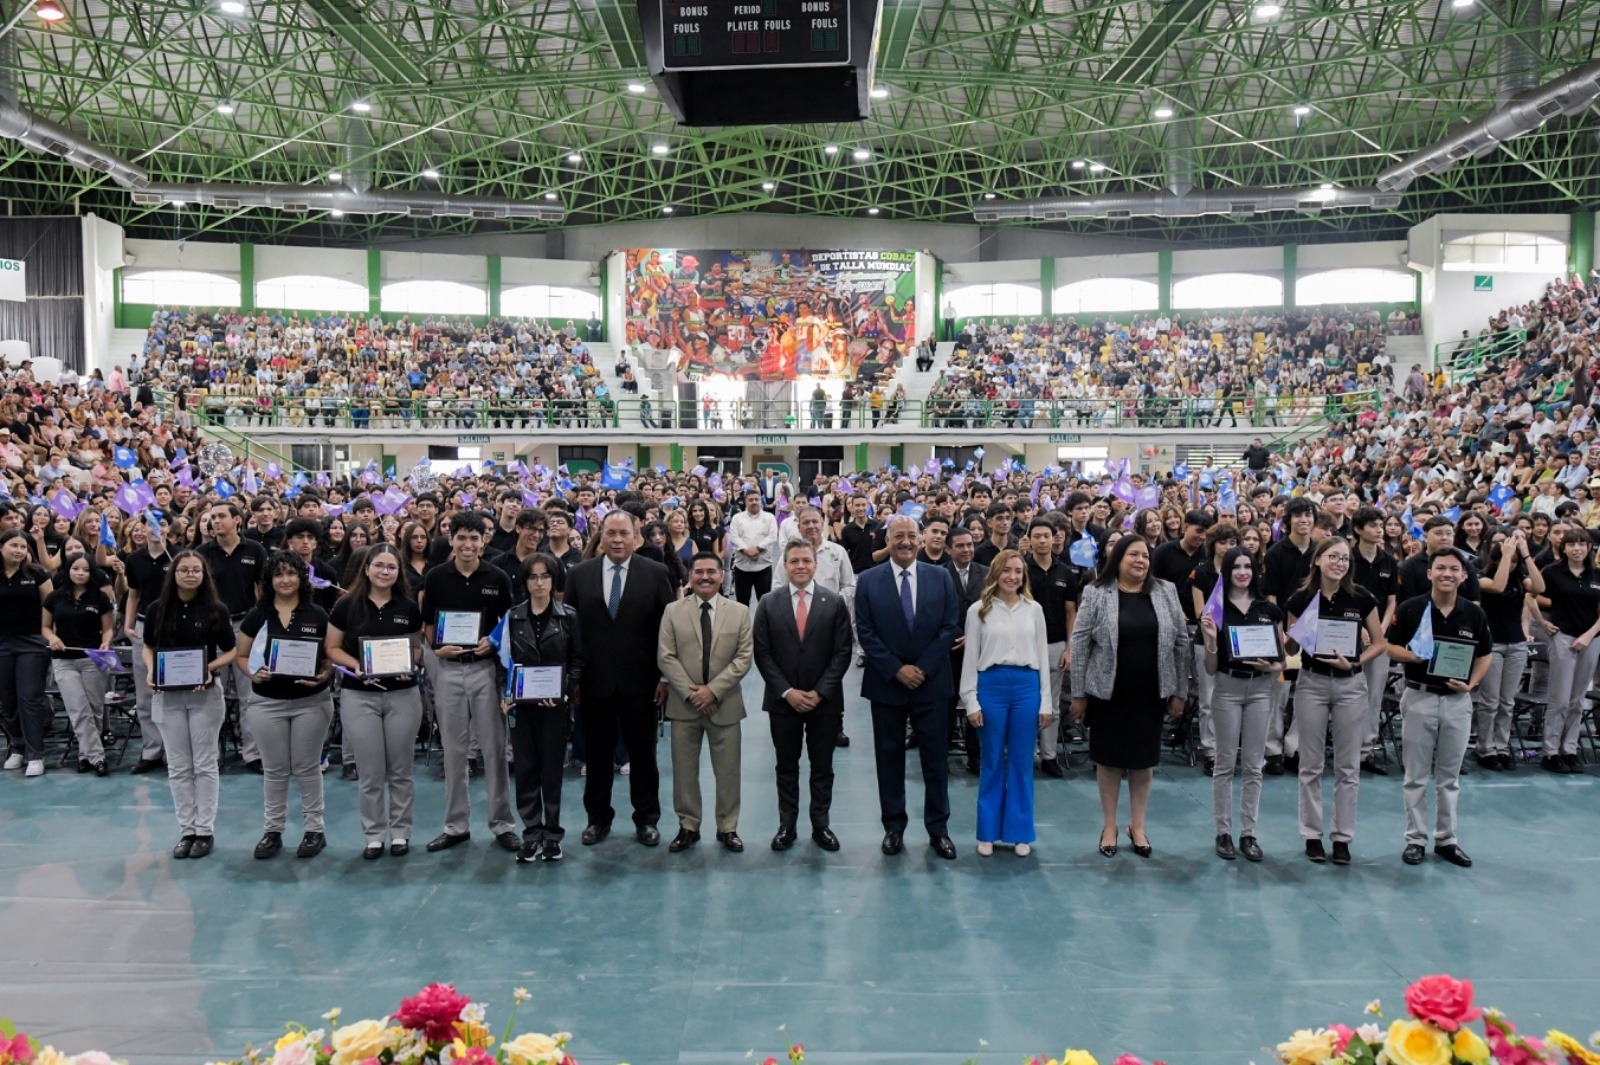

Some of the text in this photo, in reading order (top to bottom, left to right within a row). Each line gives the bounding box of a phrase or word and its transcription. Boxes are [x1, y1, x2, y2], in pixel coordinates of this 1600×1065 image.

[680, 6, 708, 17] BONUS
[734, 5, 761, 15] PERIOD
[801, 2, 830, 12] BONUS
[673, 23, 700, 34] FOULS
[727, 19, 791, 32] PLAYER FOULS
[811, 18, 838, 29] FOULS
[812, 251, 879, 262] DEPORTISTAS
[820, 261, 912, 272] DE TALLA MUNDIAL
[757, 436, 787, 444] SALIDA
[1050, 434, 1079, 442] SALIDA
